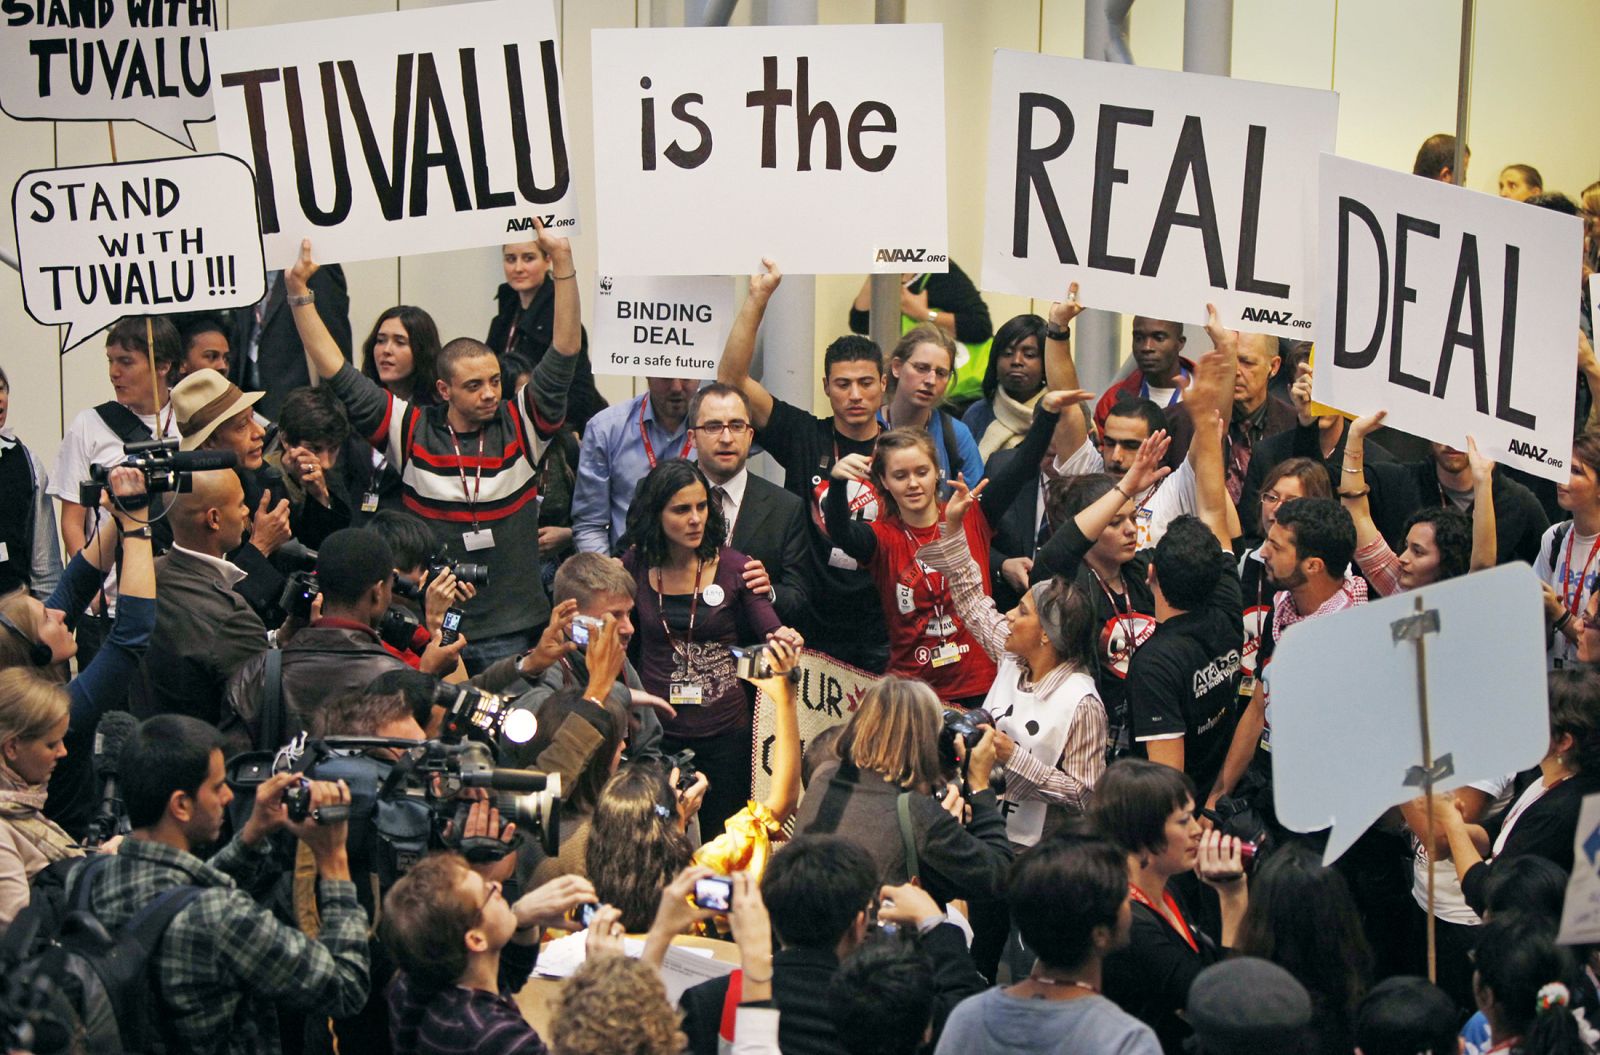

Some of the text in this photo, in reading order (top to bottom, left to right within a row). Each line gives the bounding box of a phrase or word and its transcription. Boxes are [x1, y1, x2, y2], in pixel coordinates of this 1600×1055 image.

[1, 0, 211, 28] STAND WITH
[29, 36, 212, 100] TUVALU
[220, 39, 570, 234] TUVALU
[640, 55, 897, 173] is the
[29, 177, 180, 223] STAND
[1012, 92, 1291, 299] REAL
[98, 227, 204, 257] WITH
[616, 300, 713, 323] BINDING
[1333, 195, 1537, 431] DEAL
[633, 325, 695, 346] DEAL
[610, 352, 715, 369] for a safe future
[1193, 649, 1241, 693] Arabs
